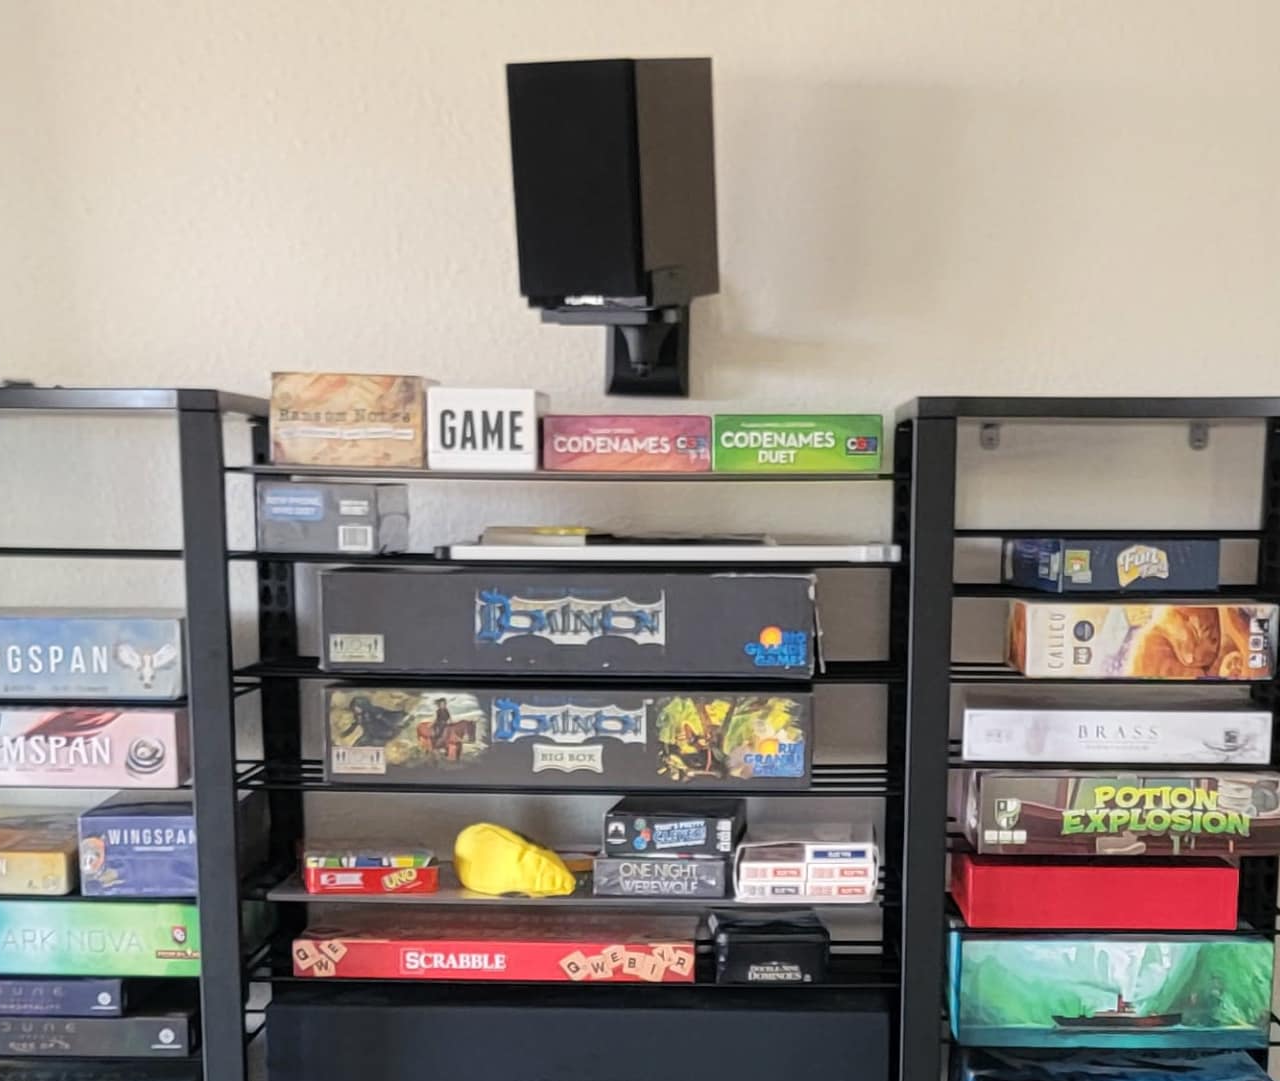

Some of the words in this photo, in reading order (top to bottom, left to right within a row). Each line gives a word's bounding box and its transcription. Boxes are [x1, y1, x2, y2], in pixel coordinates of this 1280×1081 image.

[440, 409, 524, 450] GAME
[553, 435, 671, 455] CODENAMES
[720, 431, 835, 449] CODENAMES
[758, 450, 797, 464] DUET
[1048, 613, 1065, 669] CALICO
[1078, 724, 1160, 740] BRASS
[541, 753, 564, 762] BIG
[568, 753, 596, 762] BOX
[1094, 786, 1222, 810] POTION
[1061, 809, 1251, 837] EXPLOSION
[383, 868, 418, 892] UNO
[620, 863, 652, 878] ONE
[655, 864, 698, 879] NIGHT
[622, 880, 698, 894] WEREWOLF
[2, 929, 56, 951] ARK
[66, 930, 144, 953] NOVA
[405, 951, 507, 970] SCRABBLE
